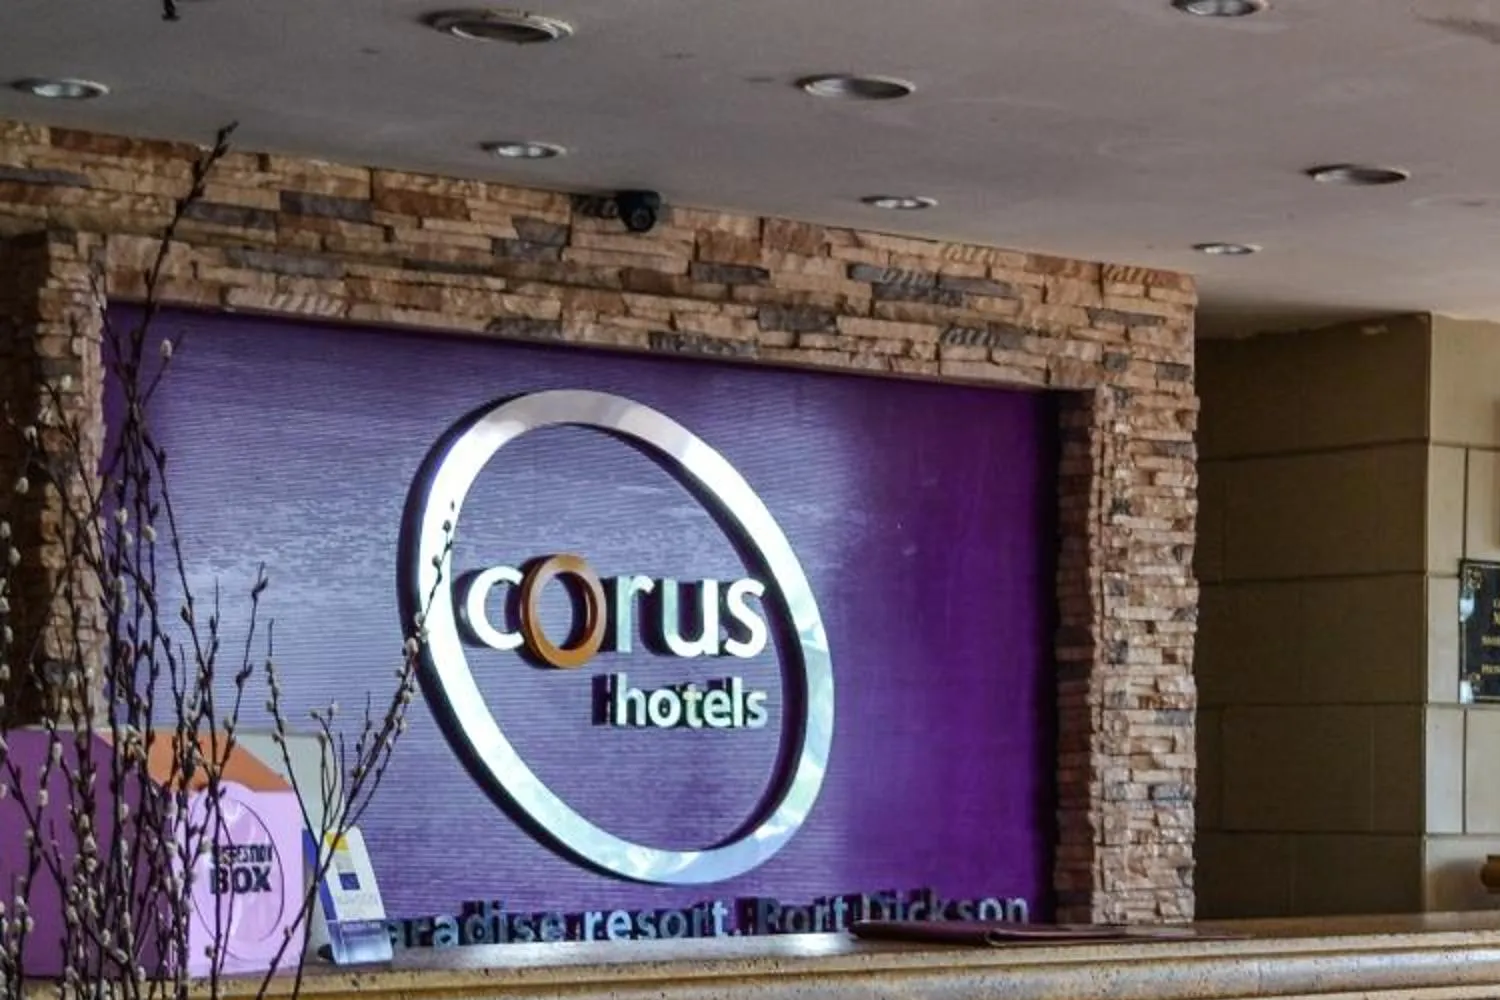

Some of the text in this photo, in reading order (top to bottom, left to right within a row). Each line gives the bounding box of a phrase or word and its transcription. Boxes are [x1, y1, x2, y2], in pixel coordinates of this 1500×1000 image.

[466, 553, 767, 669] corus
[616, 672, 769, 728] hotels
[210, 865, 273, 895] BOX
[386, 897, 567, 950] aradise
[757, 895, 849, 934] Port
[860, 884, 1030, 924] Dickson
